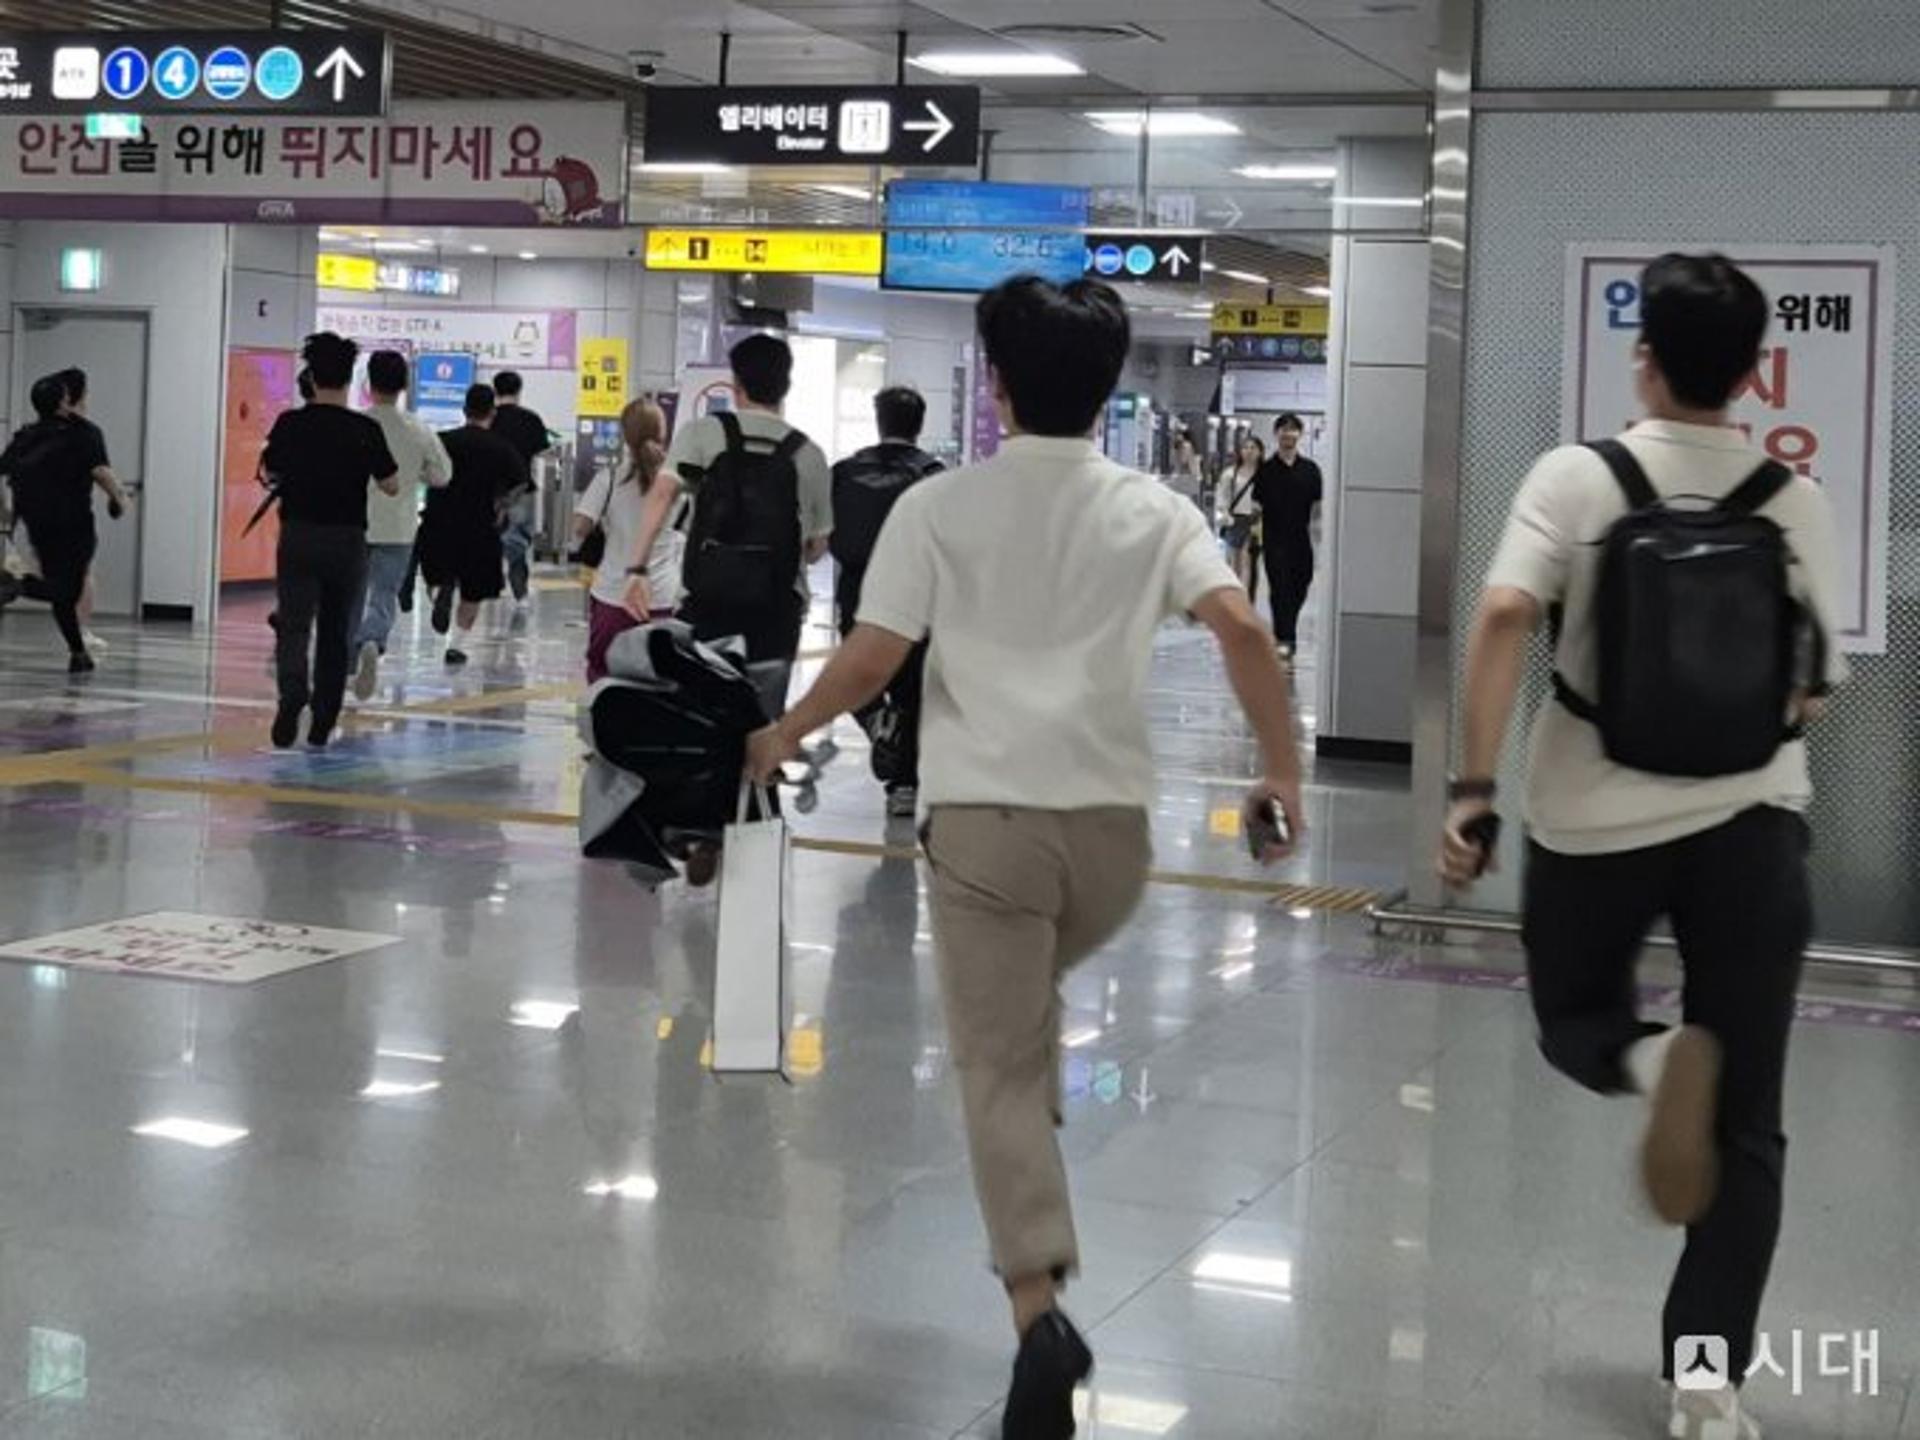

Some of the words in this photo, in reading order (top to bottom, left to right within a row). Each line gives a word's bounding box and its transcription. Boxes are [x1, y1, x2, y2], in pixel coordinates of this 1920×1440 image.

[116, 56, 132, 91] 1
[162, 56, 186, 90] 4
[718, 104, 829, 132] 엘리베이터
[175, 124, 265, 175] 위해
[1776, 295, 1851, 332] 위해
